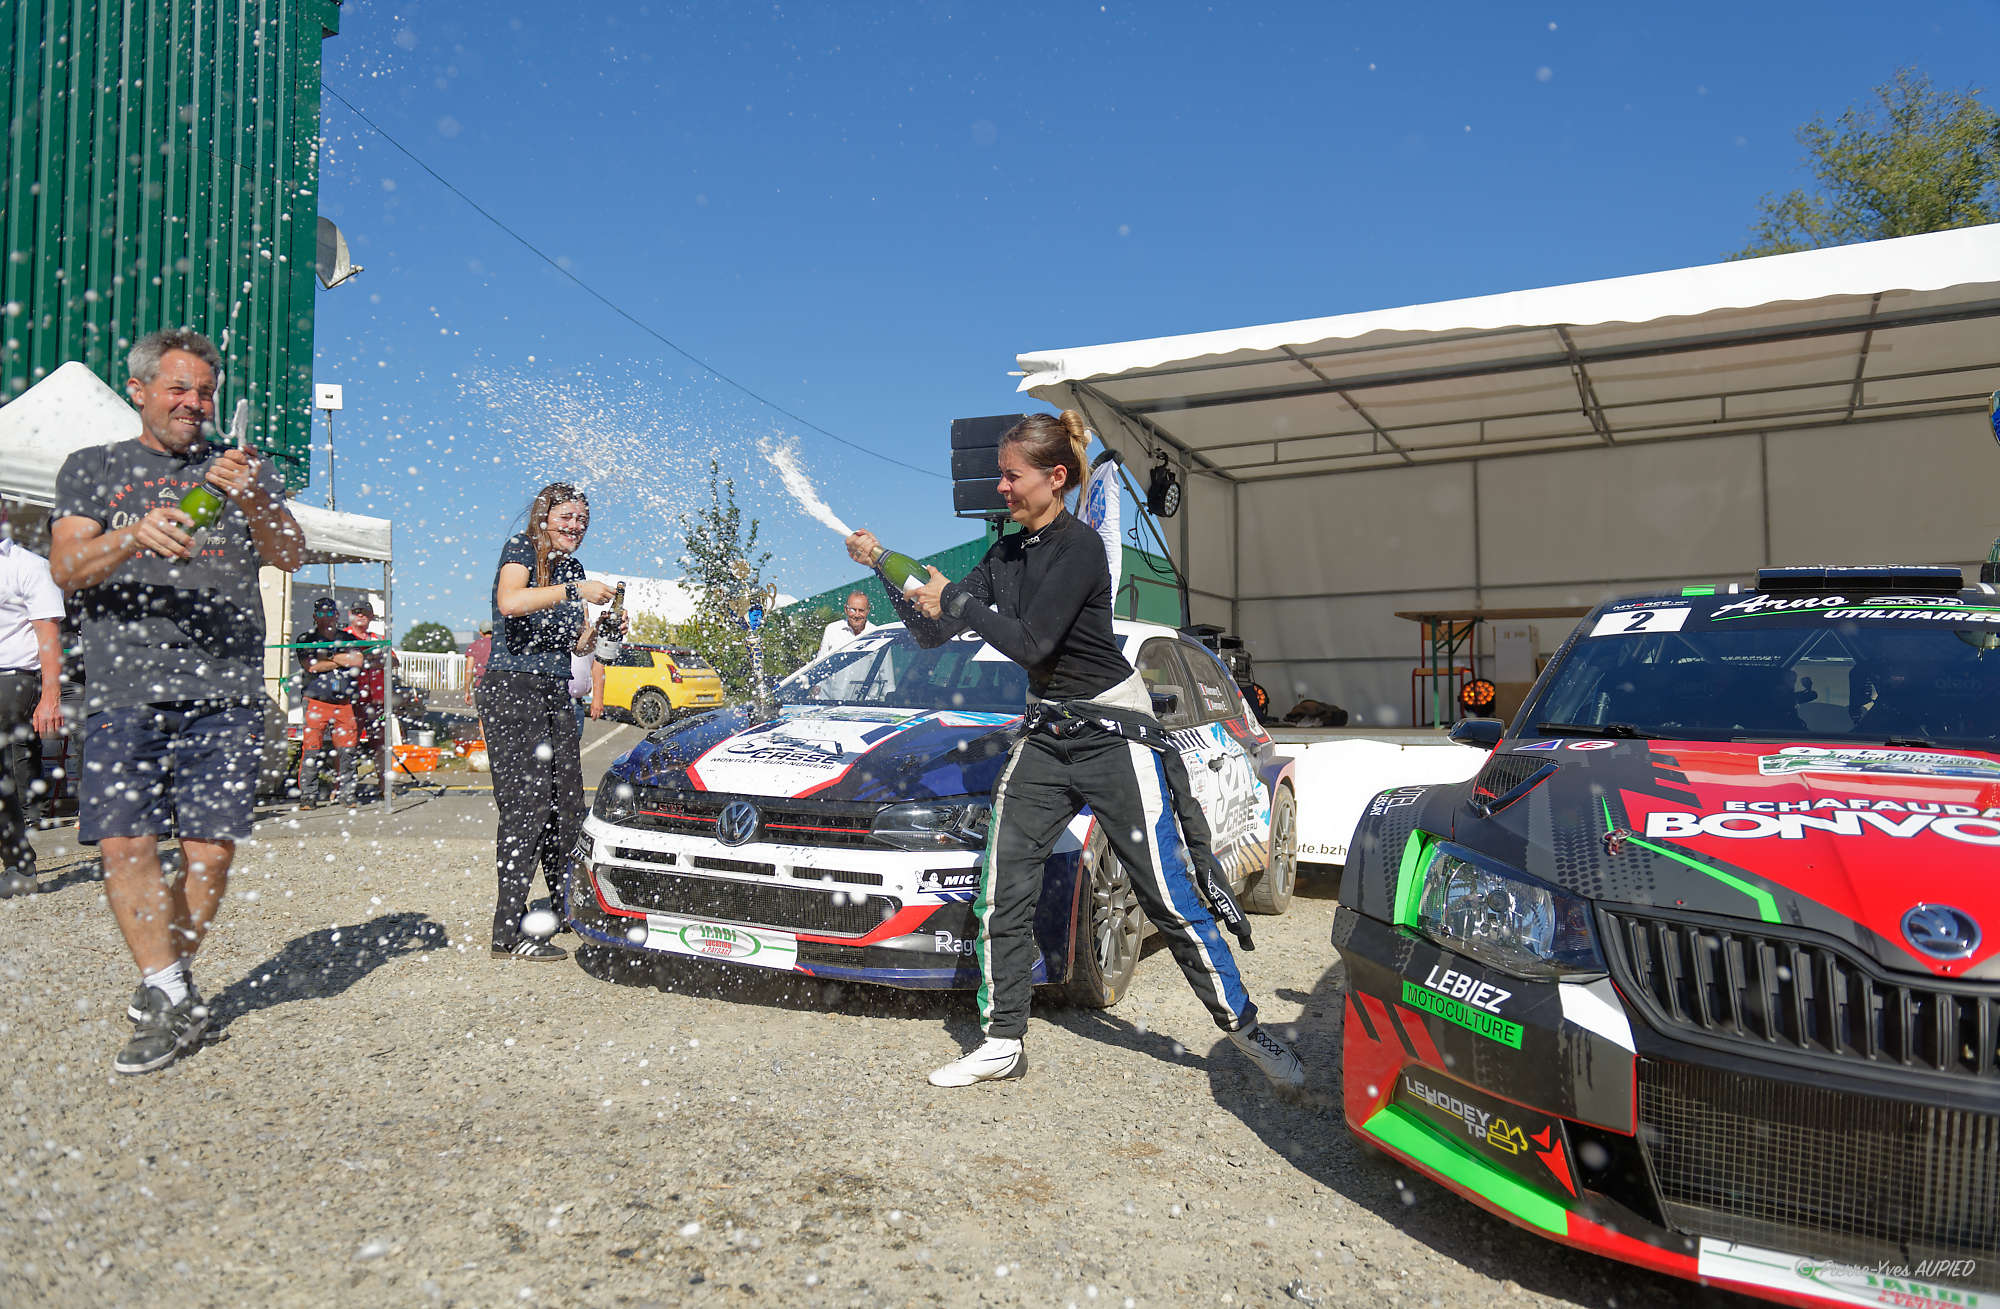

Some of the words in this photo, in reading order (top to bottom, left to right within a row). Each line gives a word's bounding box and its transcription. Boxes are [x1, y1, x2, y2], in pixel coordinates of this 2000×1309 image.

[1710, 594, 1850, 618] Anno
[1624, 611, 1655, 632] 2
[751, 751, 844, 765] CASSE
[935, 930, 977, 956] Rag
[1424, 964, 1512, 1014] LEBIEZ
[1407, 985, 1515, 1043] MOTOCULTURE
[1405, 1076, 1490, 1127] LEHODEY
[1464, 1120, 1487, 1139] TP
